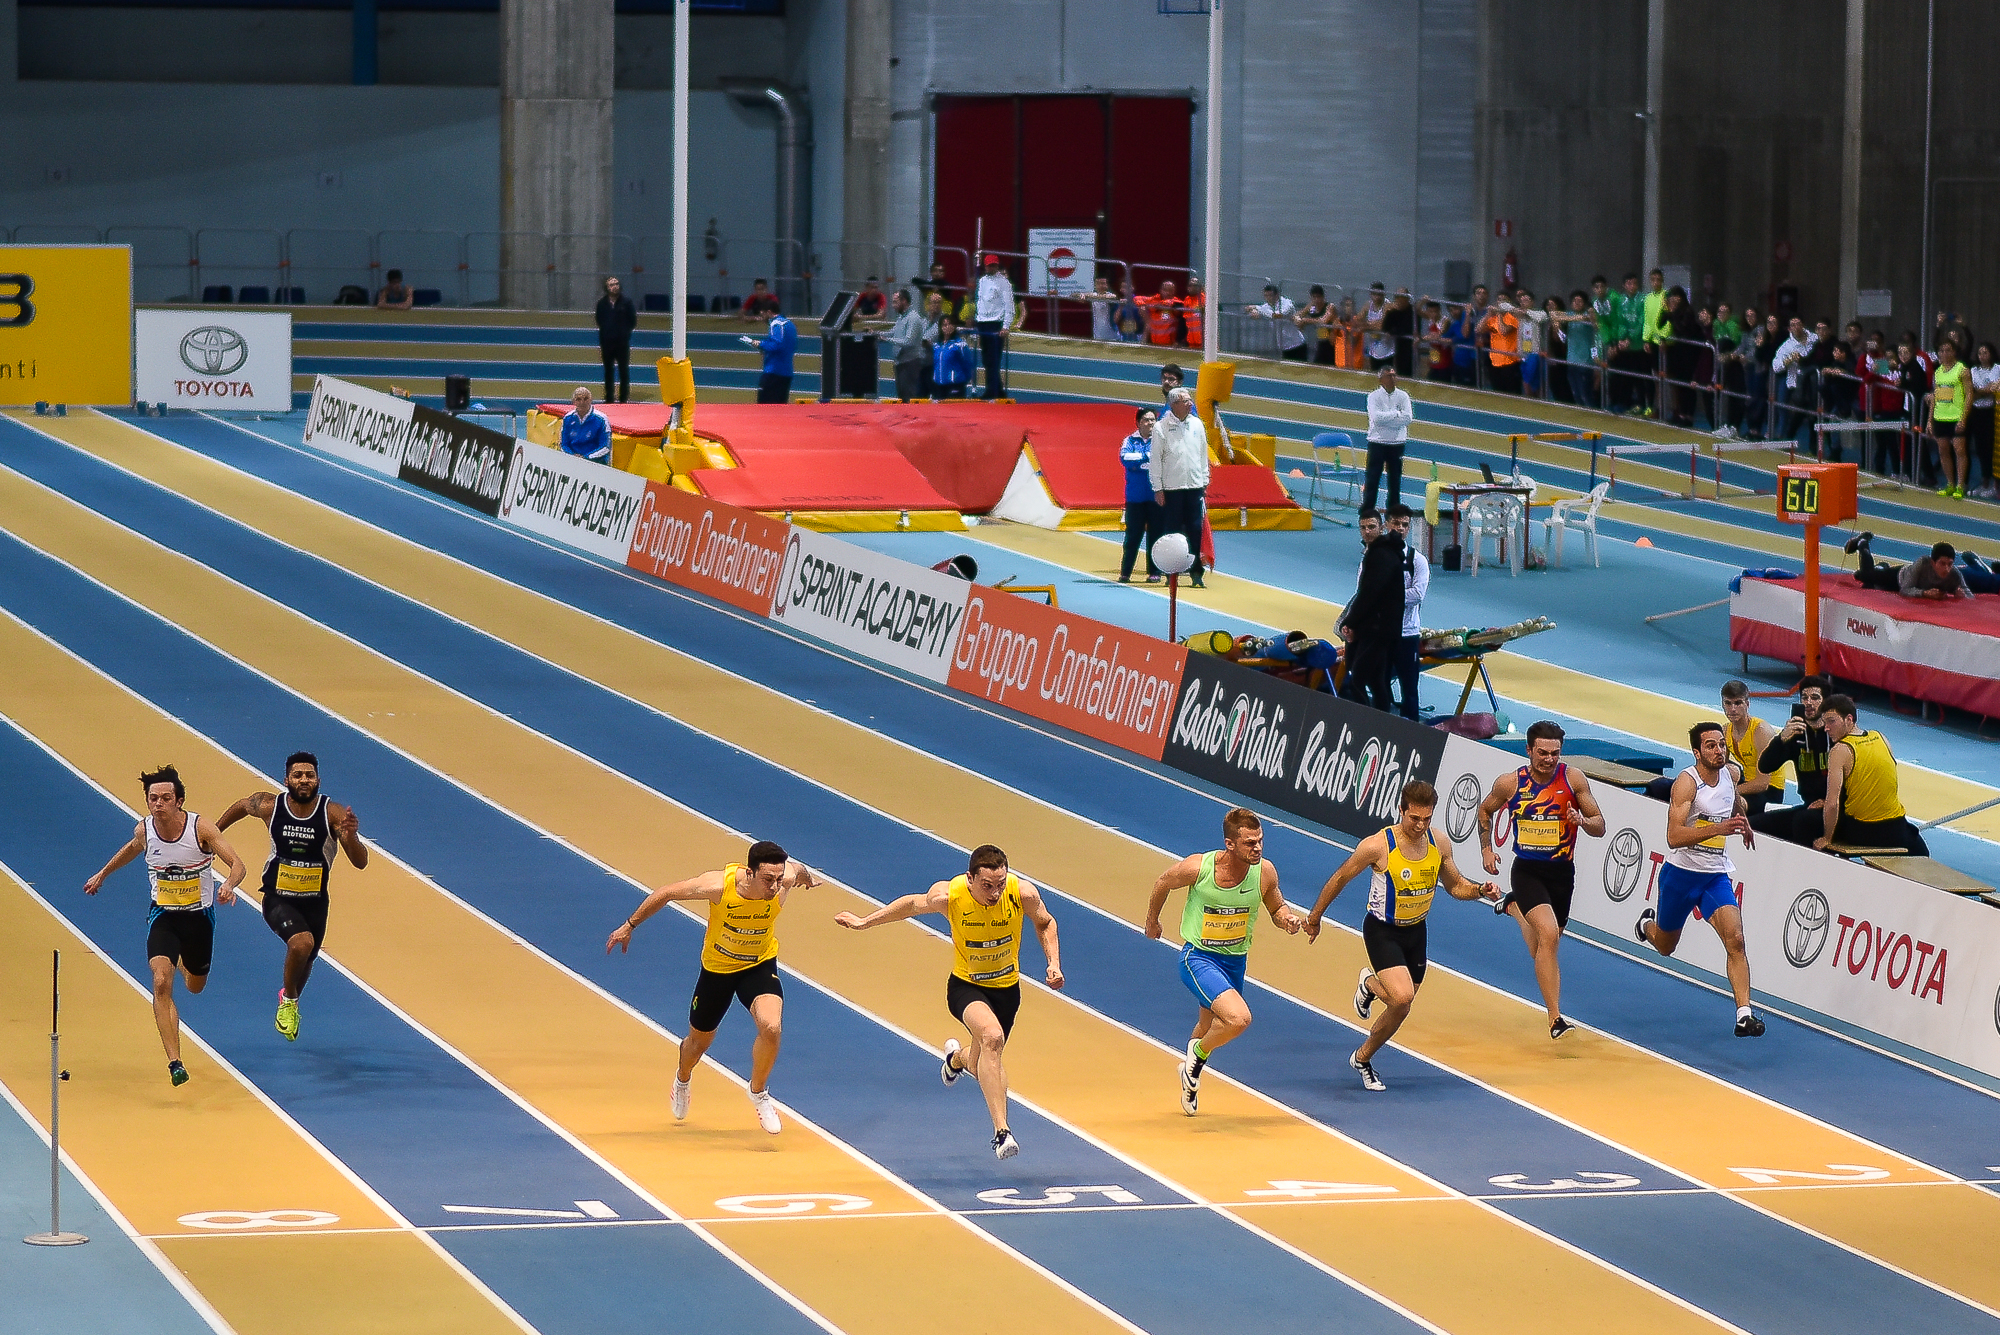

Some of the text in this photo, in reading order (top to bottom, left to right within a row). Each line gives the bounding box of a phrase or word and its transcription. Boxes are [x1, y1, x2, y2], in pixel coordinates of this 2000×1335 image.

[174, 379, 254, 398] TOYOTA
[316, 394, 412, 459] SPRINT ACADEMY
[516, 462, 640, 543] SPRINT ACADEMY
[1786, 478, 1819, 513] 60
[634, 491, 788, 599] Gruppo Confalonieri
[793, 554, 963, 658] SPRINT ACADEMY
[954, 597, 1182, 739] Gruppo Confalonieri
[1172, 678, 1289, 779] Radio Italia
[1294, 720, 1356, 803] Radio
[283, 824, 315, 834] ATLETICA
[159, 885, 199, 895] FASTWEB
[1204, 920, 1246, 930] FASTWEB
[1831, 914, 1948, 1005] TOYOTA
[976, 1184, 1143, 1206] 5
[1244, 1180, 1400, 1197] 4
[1487, 1171, 1641, 1190] 3
[177, 1210, 339, 1230] 8
